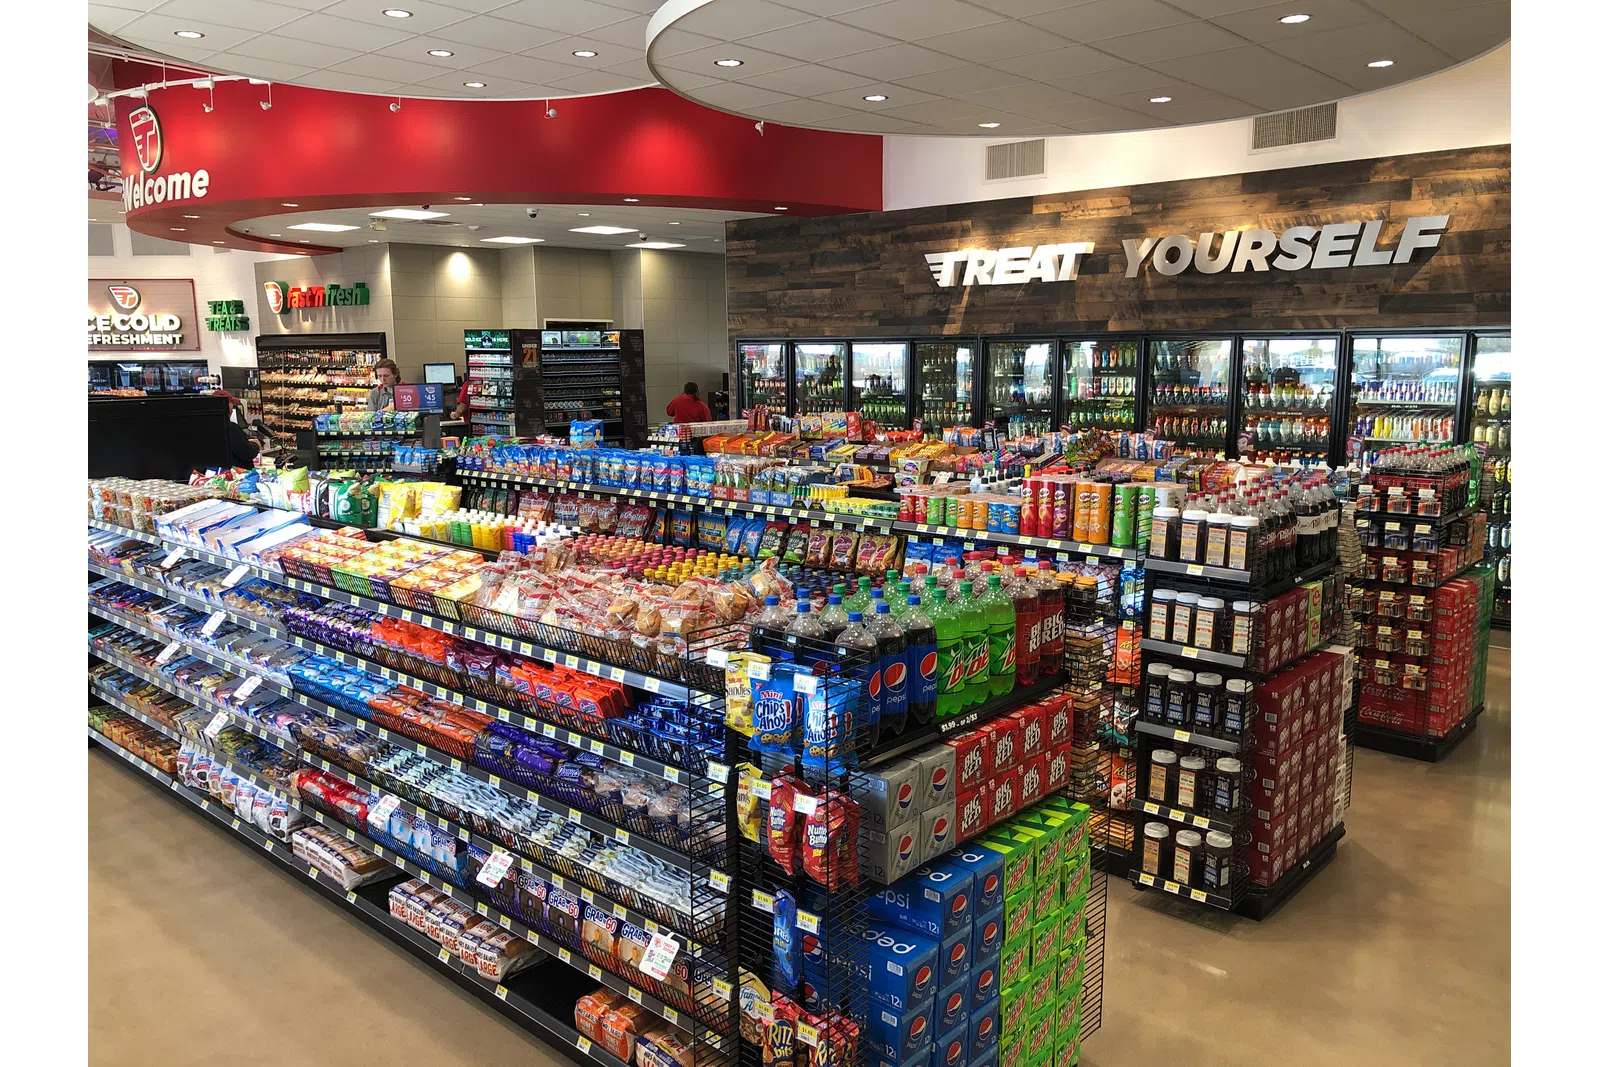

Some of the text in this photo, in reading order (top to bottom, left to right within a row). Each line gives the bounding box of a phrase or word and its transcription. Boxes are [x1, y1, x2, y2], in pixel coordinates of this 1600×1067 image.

[122, 169, 209, 212] Welcome
[924, 215, 1449, 287] TREAT YOURSELF
[207, 301, 236, 315] TEA &
[114, 314, 182, 331] COLD
[205, 318, 242, 331] TREATS
[523, 348, 537, 364] 21
[1043, 609, 1063, 632] BIG
[1041, 621, 1064, 644] RED
[761, 690, 783, 700] Mini
[755, 700, 785, 720] Chips
[1053, 706, 1067, 727] BIG
[941, 720, 955, 732] $1.99
[960, 718, 966, 726] or
[966, 713, 978, 723] 2/$3
[1025, 717, 1039, 740] BIG
[997, 730, 1011, 756] BIG
[964, 745, 980, 770] BIG
[1051, 751, 1064, 773] BIG
[1023, 764, 1037, 787] BIG
[995, 778, 1009, 803] BIG
[963, 794, 979, 819] BIG
[517, 875, 547, 900] GRAB GO
[548, 891, 579, 918] GRAB GO
[585, 905, 617, 934] GRAB GO
[621, 923, 643, 940] GRAB
[675, 962, 688, 980] GO
[767, 1022, 793, 1046] RITZ
[773, 1046, 793, 1059] bits
